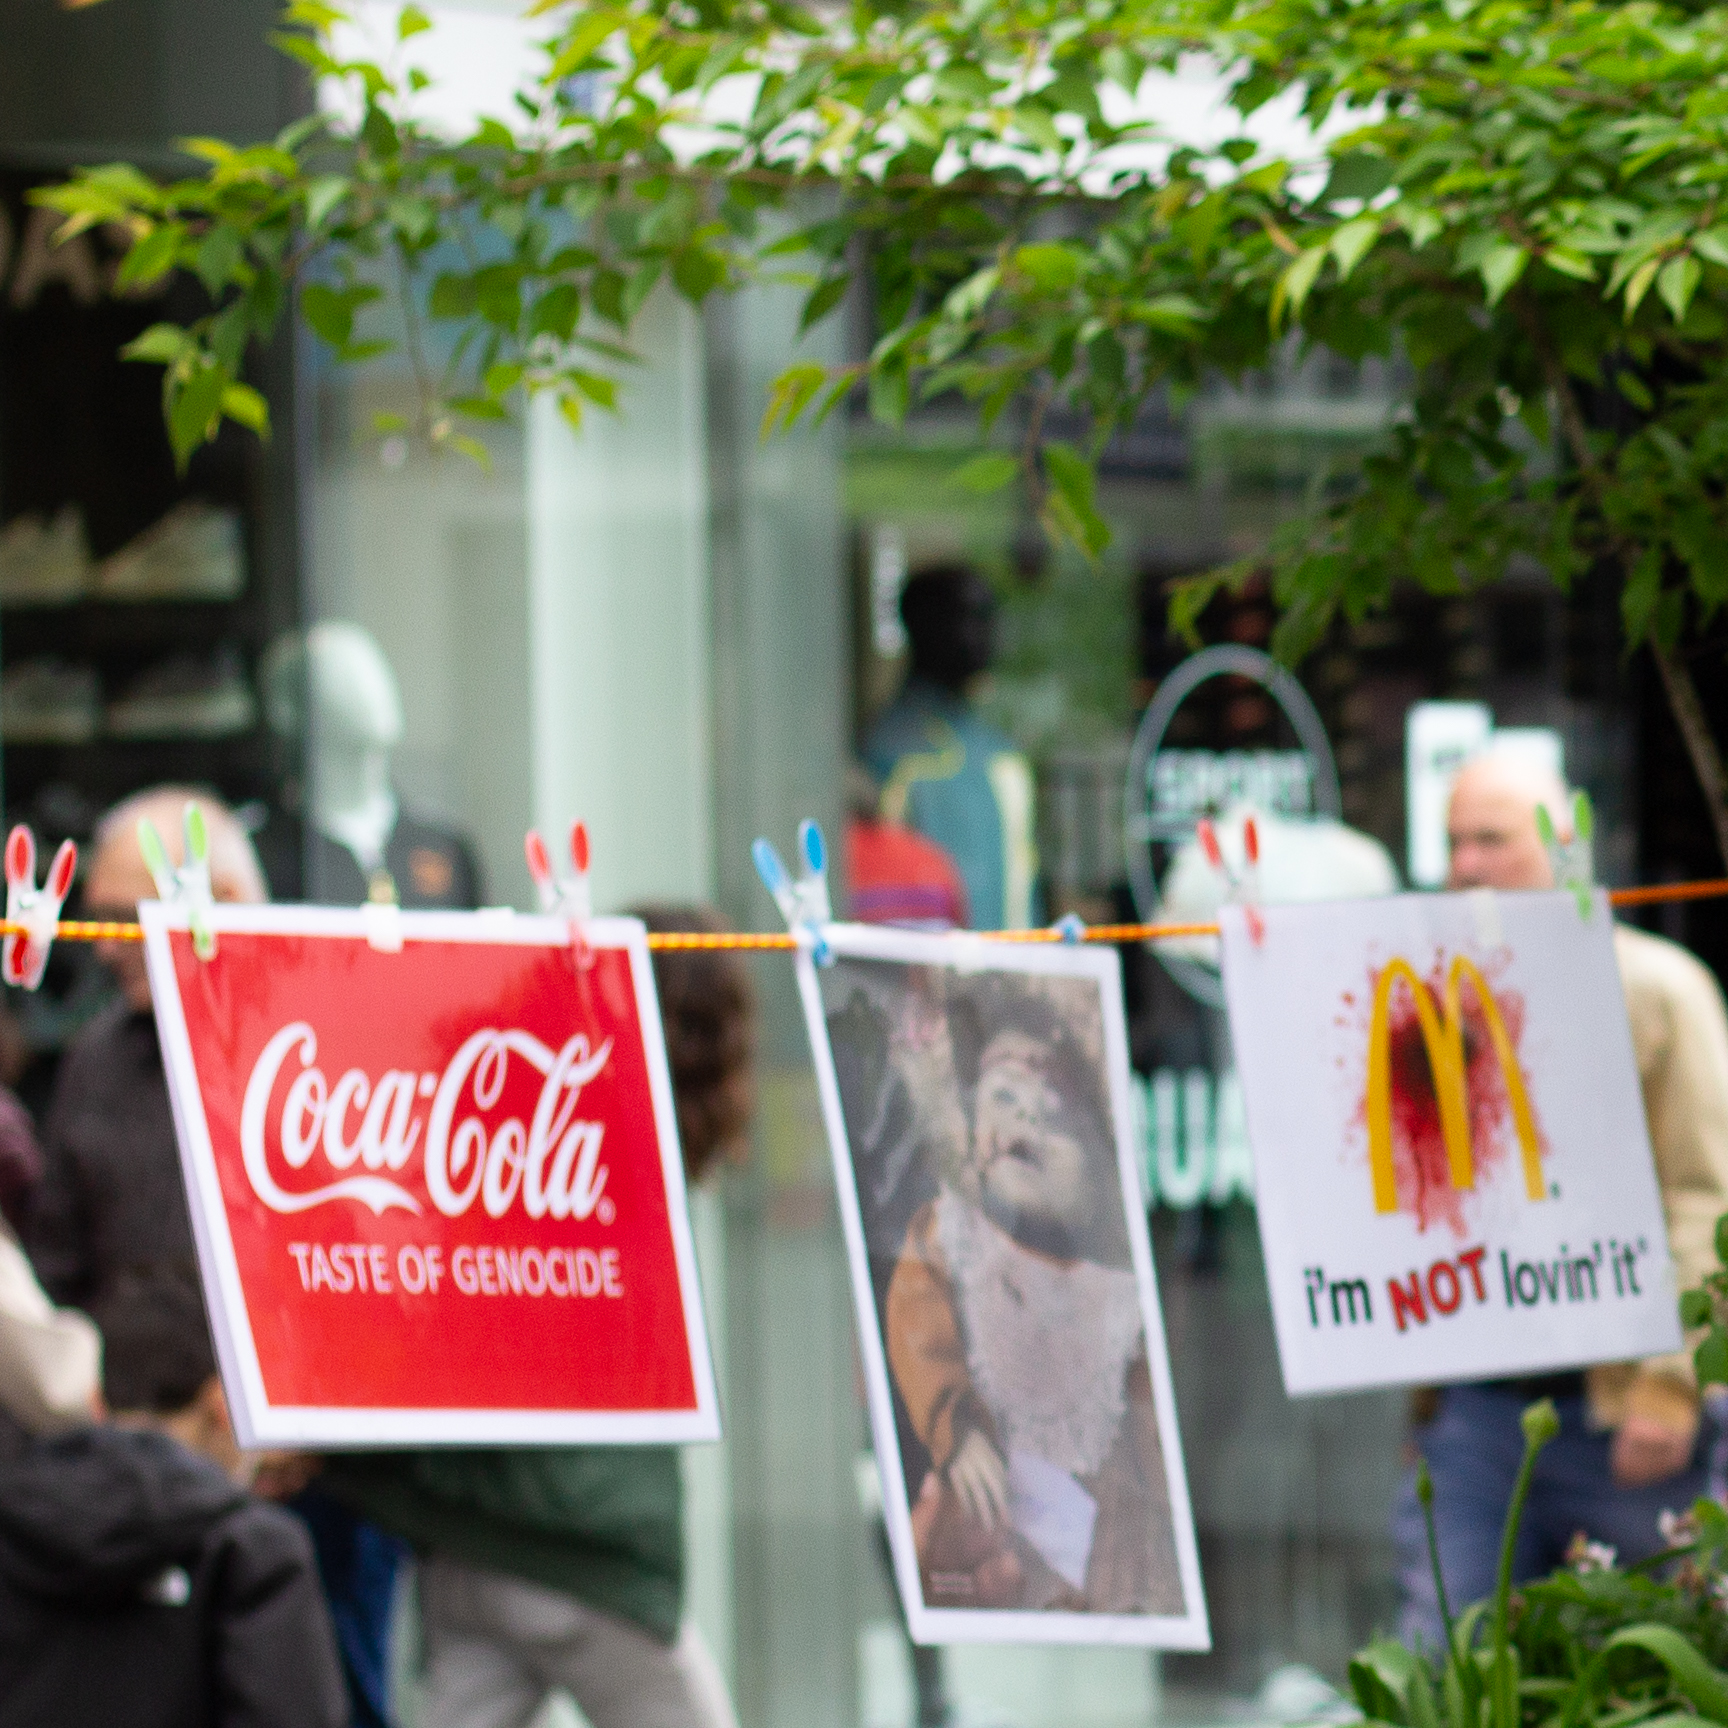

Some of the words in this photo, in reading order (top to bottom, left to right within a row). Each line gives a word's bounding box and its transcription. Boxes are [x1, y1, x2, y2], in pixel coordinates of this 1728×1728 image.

[240, 1021, 614, 1222] Coca-Cola
[288, 1243, 392, 1294] TASTE
[397, 1245, 445, 1294] OF
[452, 1245, 624, 1298] GENOCIDE
[1304, 1266, 1373, 1327] i'm
[1387, 1246, 1487, 1332] NOT
[1500, 1241, 1602, 1308] lovin'
